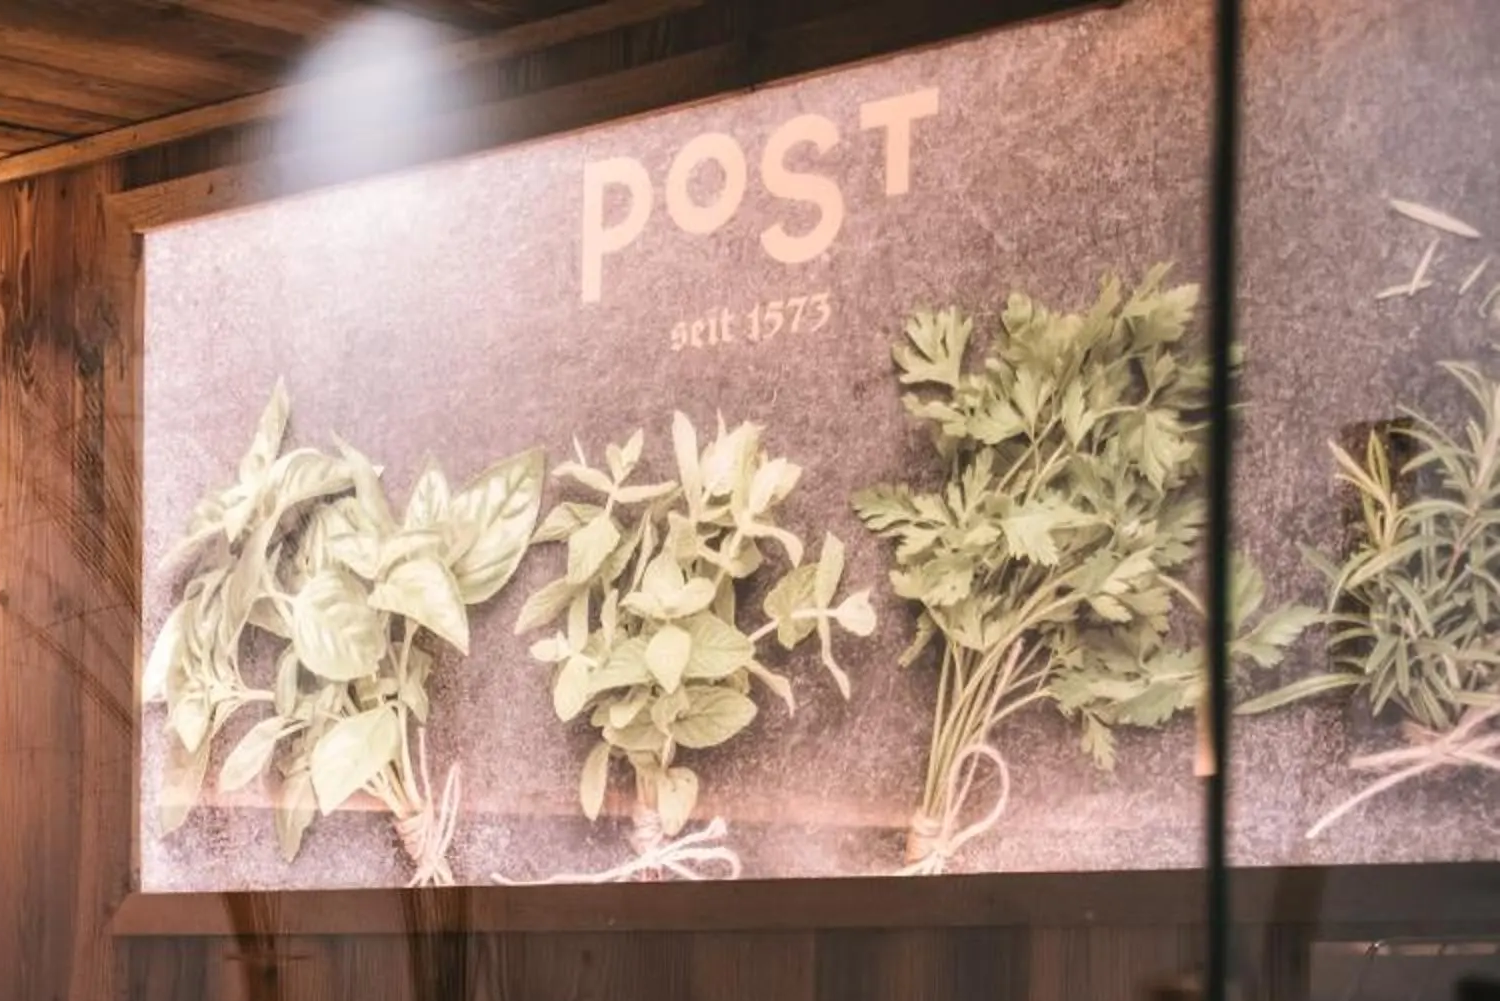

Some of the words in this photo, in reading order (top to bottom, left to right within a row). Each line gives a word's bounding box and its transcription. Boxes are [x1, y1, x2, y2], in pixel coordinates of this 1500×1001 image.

[582, 87, 938, 302] POST
[670, 310, 736, 352] seit
[746, 291, 833, 341] 1573
